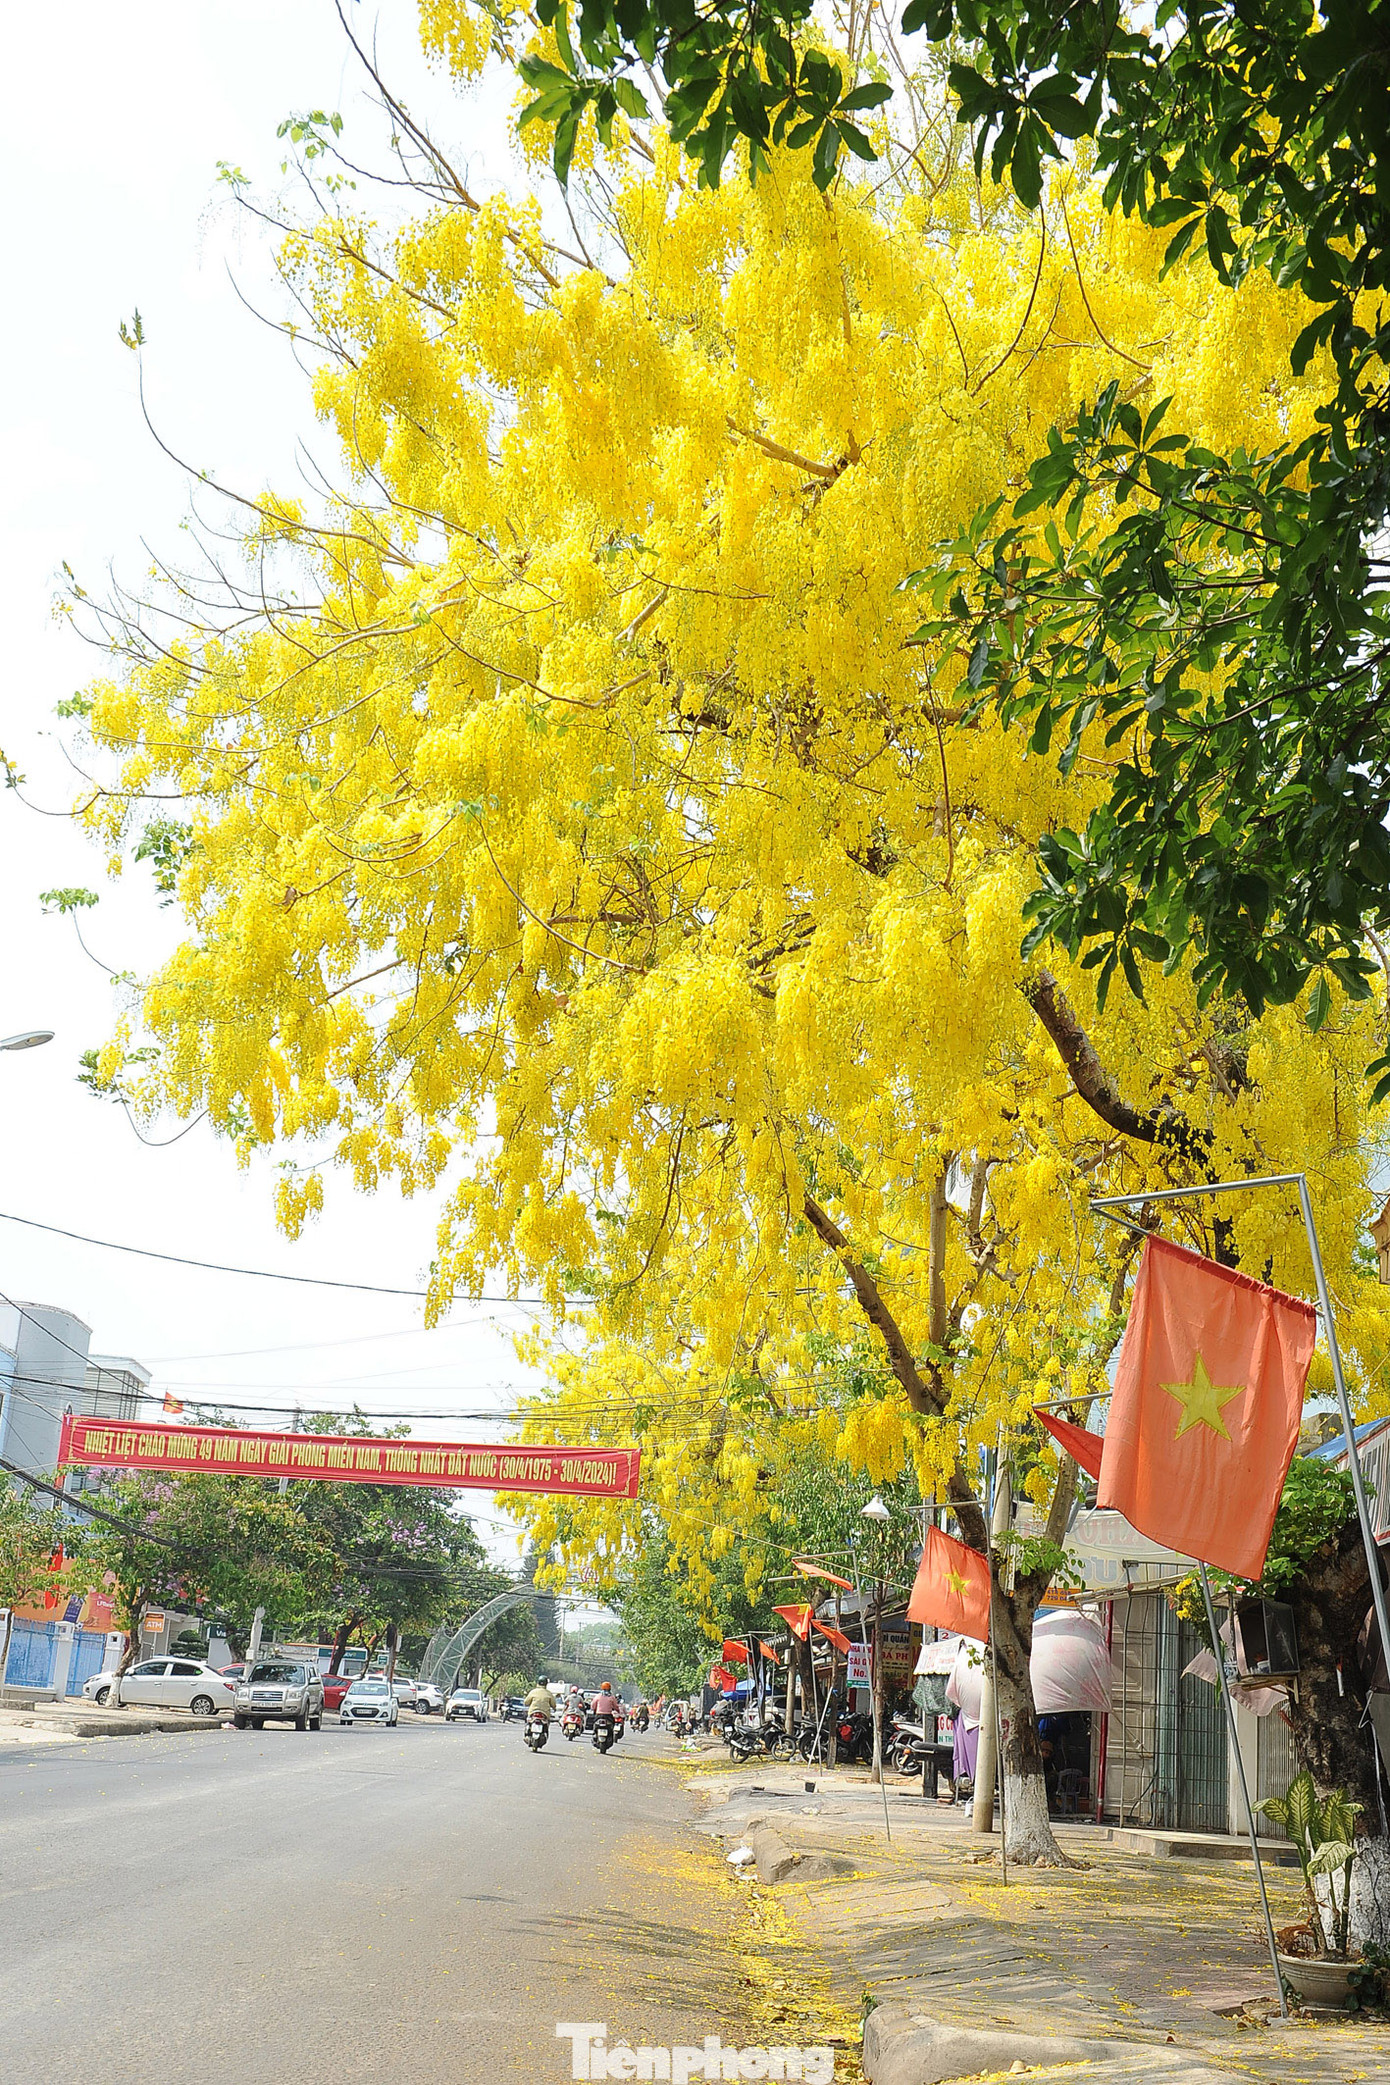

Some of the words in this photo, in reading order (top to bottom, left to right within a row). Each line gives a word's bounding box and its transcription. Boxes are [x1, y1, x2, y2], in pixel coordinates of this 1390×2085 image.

[84, 1426, 115, 1459] NHIỆT
[115, 1428, 137, 1460] LIỆT
[138, 1430, 166, 1457] CHÀO
[167, 1432, 198, 1459] MỪNG
[199, 1438, 212, 1460] 49
[213, 1435, 239, 1462] NĂM
[239, 1436, 268, 1464] NGÀY
[268, 1436, 290, 1465] GIẢI
[291, 1440, 326, 1467] PHÓNG
[327, 1440, 354, 1469] MIỀN
[355, 1447, 382, 1473] NAM,
[385, 1442, 418, 1473] THỐNG
[419, 1445, 446, 1475] NHẤT
[447, 1446, 468, 1476] ĐẤT
[469, 1450, 497, 1478] NƯỚC
[499, 1455, 552, 1482] (30/4/1975
[560, 1459, 617, 1487] 30/4/2024)!
